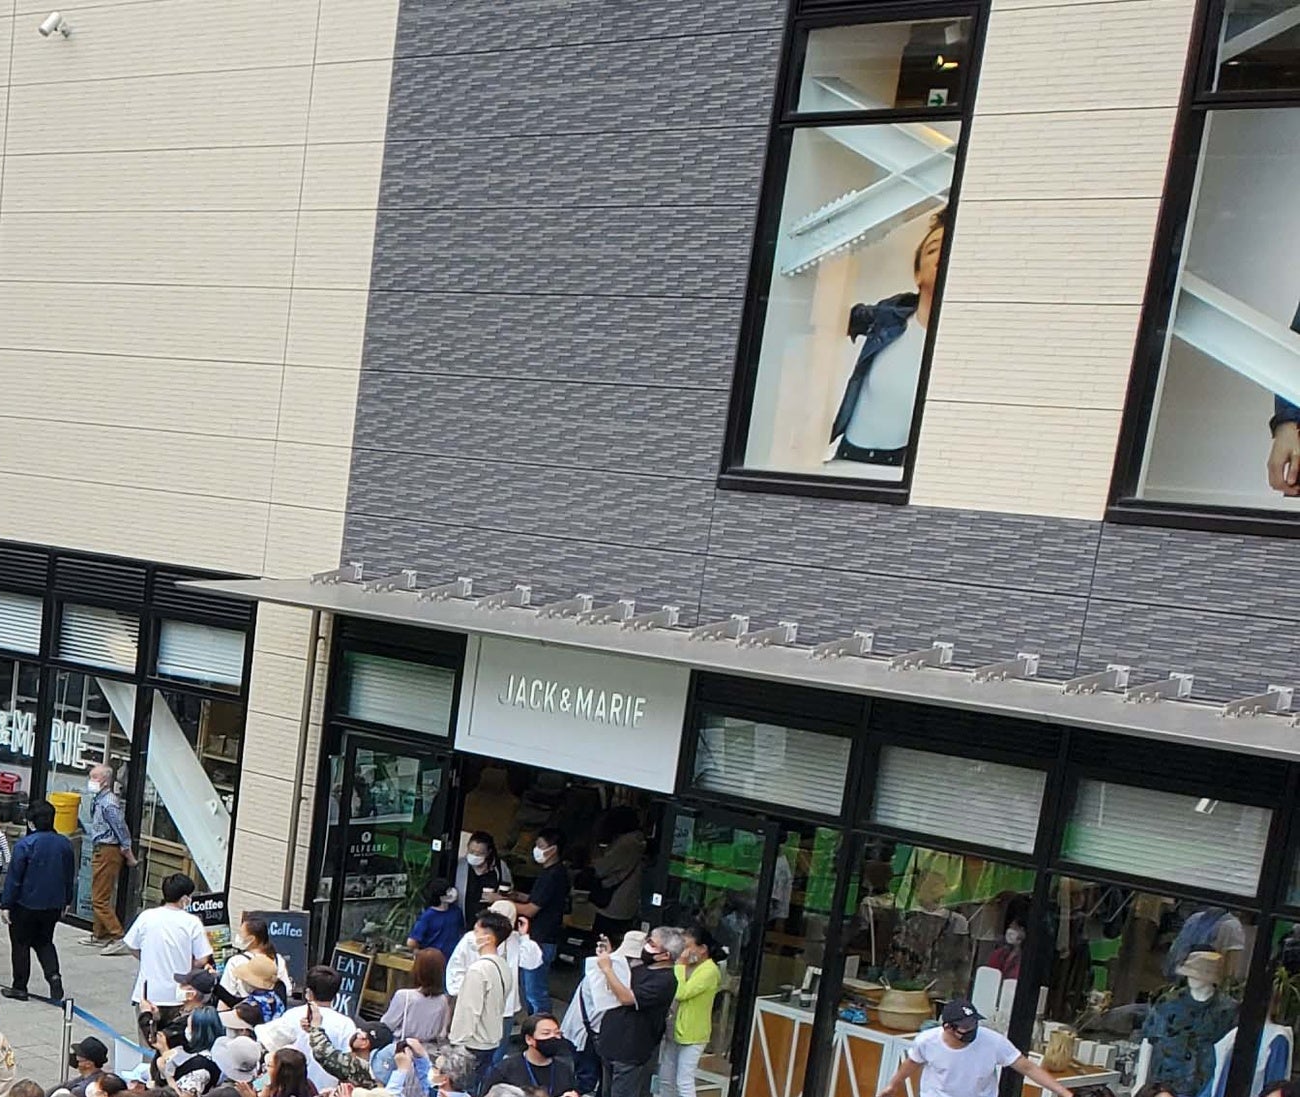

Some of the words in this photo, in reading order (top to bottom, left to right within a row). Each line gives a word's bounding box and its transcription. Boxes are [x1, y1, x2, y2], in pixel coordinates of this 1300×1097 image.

[499, 673, 647, 729] JACK&MARIE
[192, 899, 224, 912] Coffee
[336, 955, 367, 976] EAT
[340, 977, 355, 992] IN
